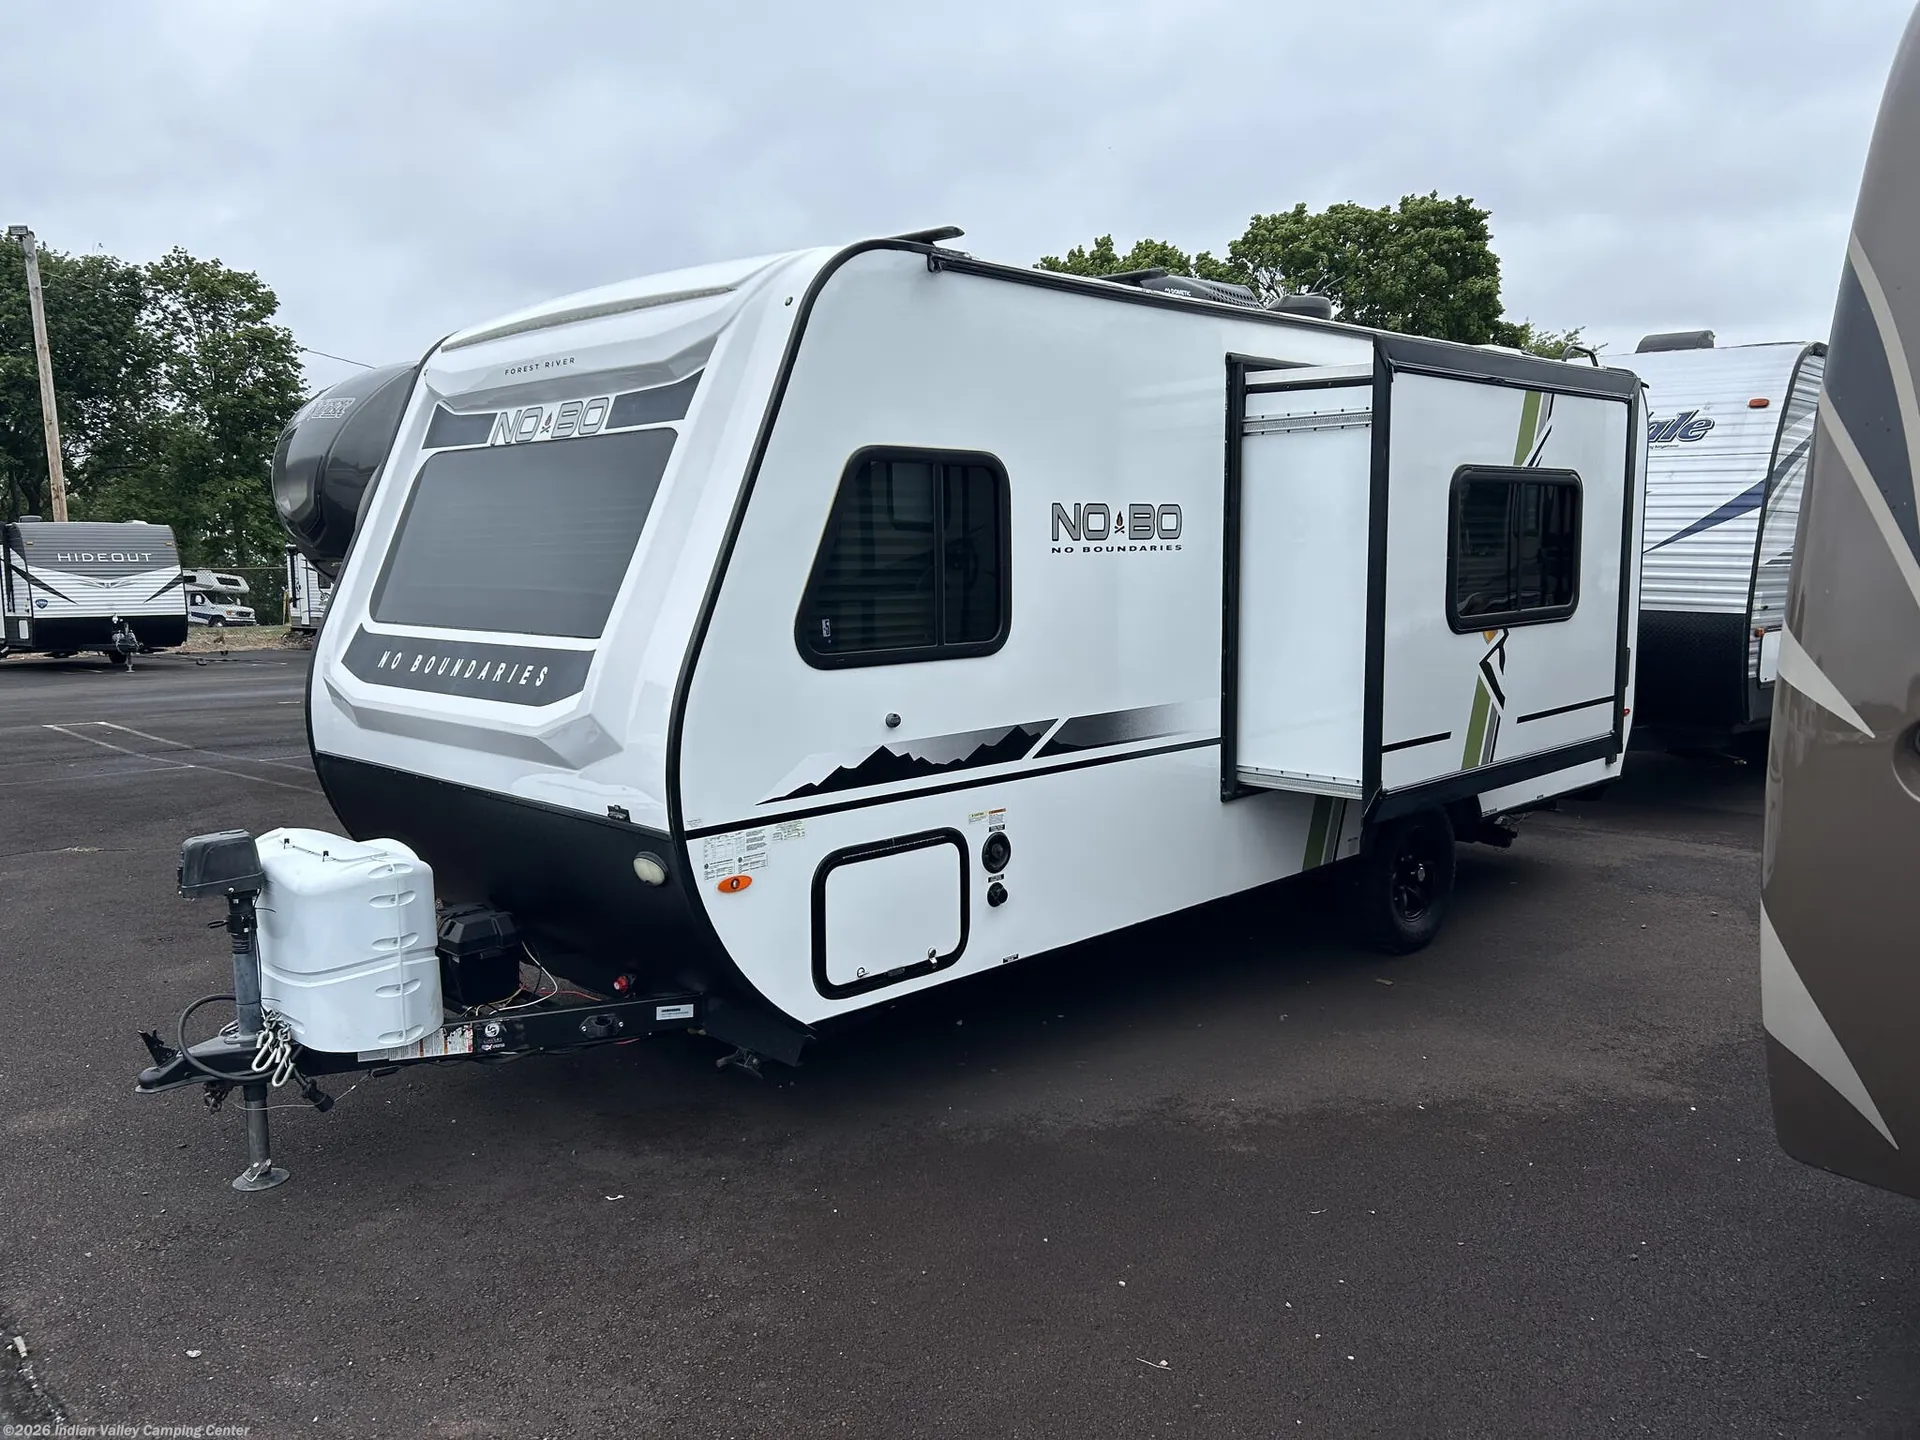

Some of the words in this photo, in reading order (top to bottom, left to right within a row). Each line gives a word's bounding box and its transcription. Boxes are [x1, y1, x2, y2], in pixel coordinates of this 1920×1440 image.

[504, 363, 540, 376] FOREST
[544, 357, 576, 368] RIVER
[1649, 409, 1715, 443] ale
[57, 552, 153, 562] HIDEOUT
[1051, 546, 1075, 554] NO
[1082, 544, 1183, 553] BOUNDARIES
[377, 650, 403, 670] NO
[410, 654, 549, 687] BOUNDARIES
